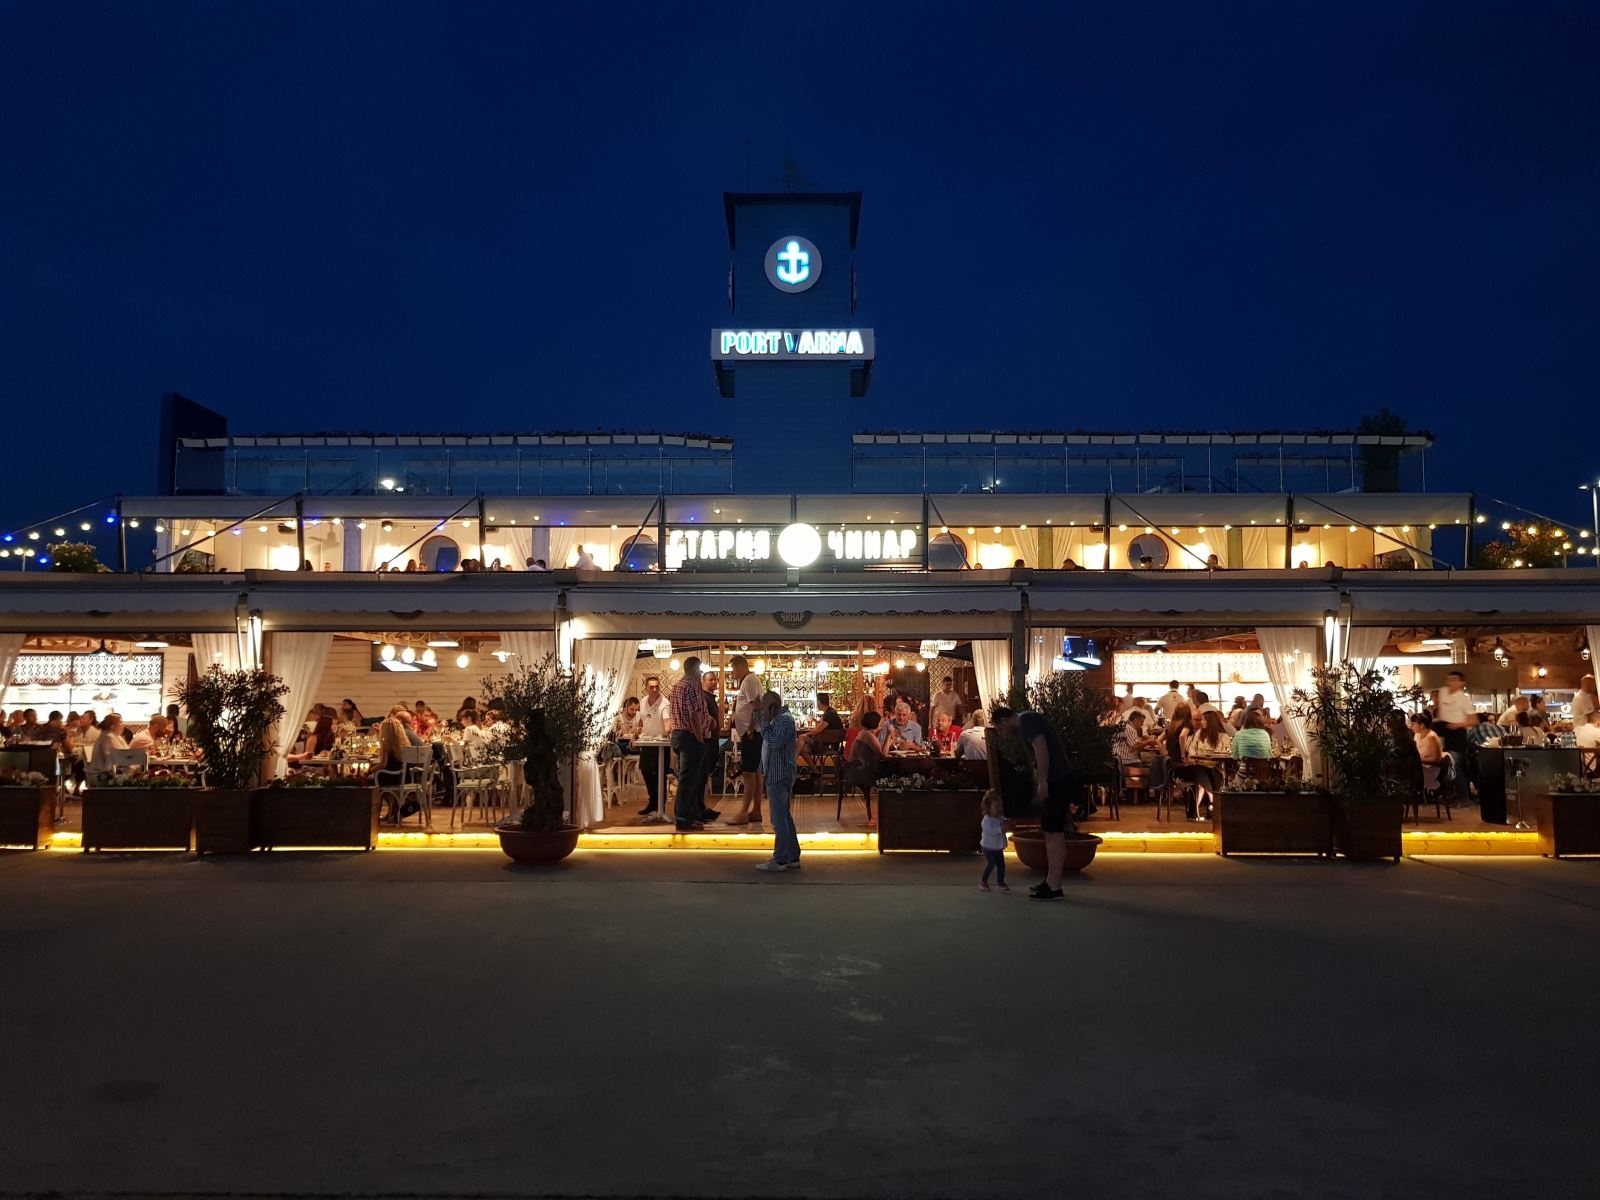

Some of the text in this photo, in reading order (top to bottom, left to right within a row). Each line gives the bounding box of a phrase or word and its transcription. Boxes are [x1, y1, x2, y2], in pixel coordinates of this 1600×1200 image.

[721, 330, 864, 355] PORT VARNA
[828, 529, 917, 560] ЧИНАР
